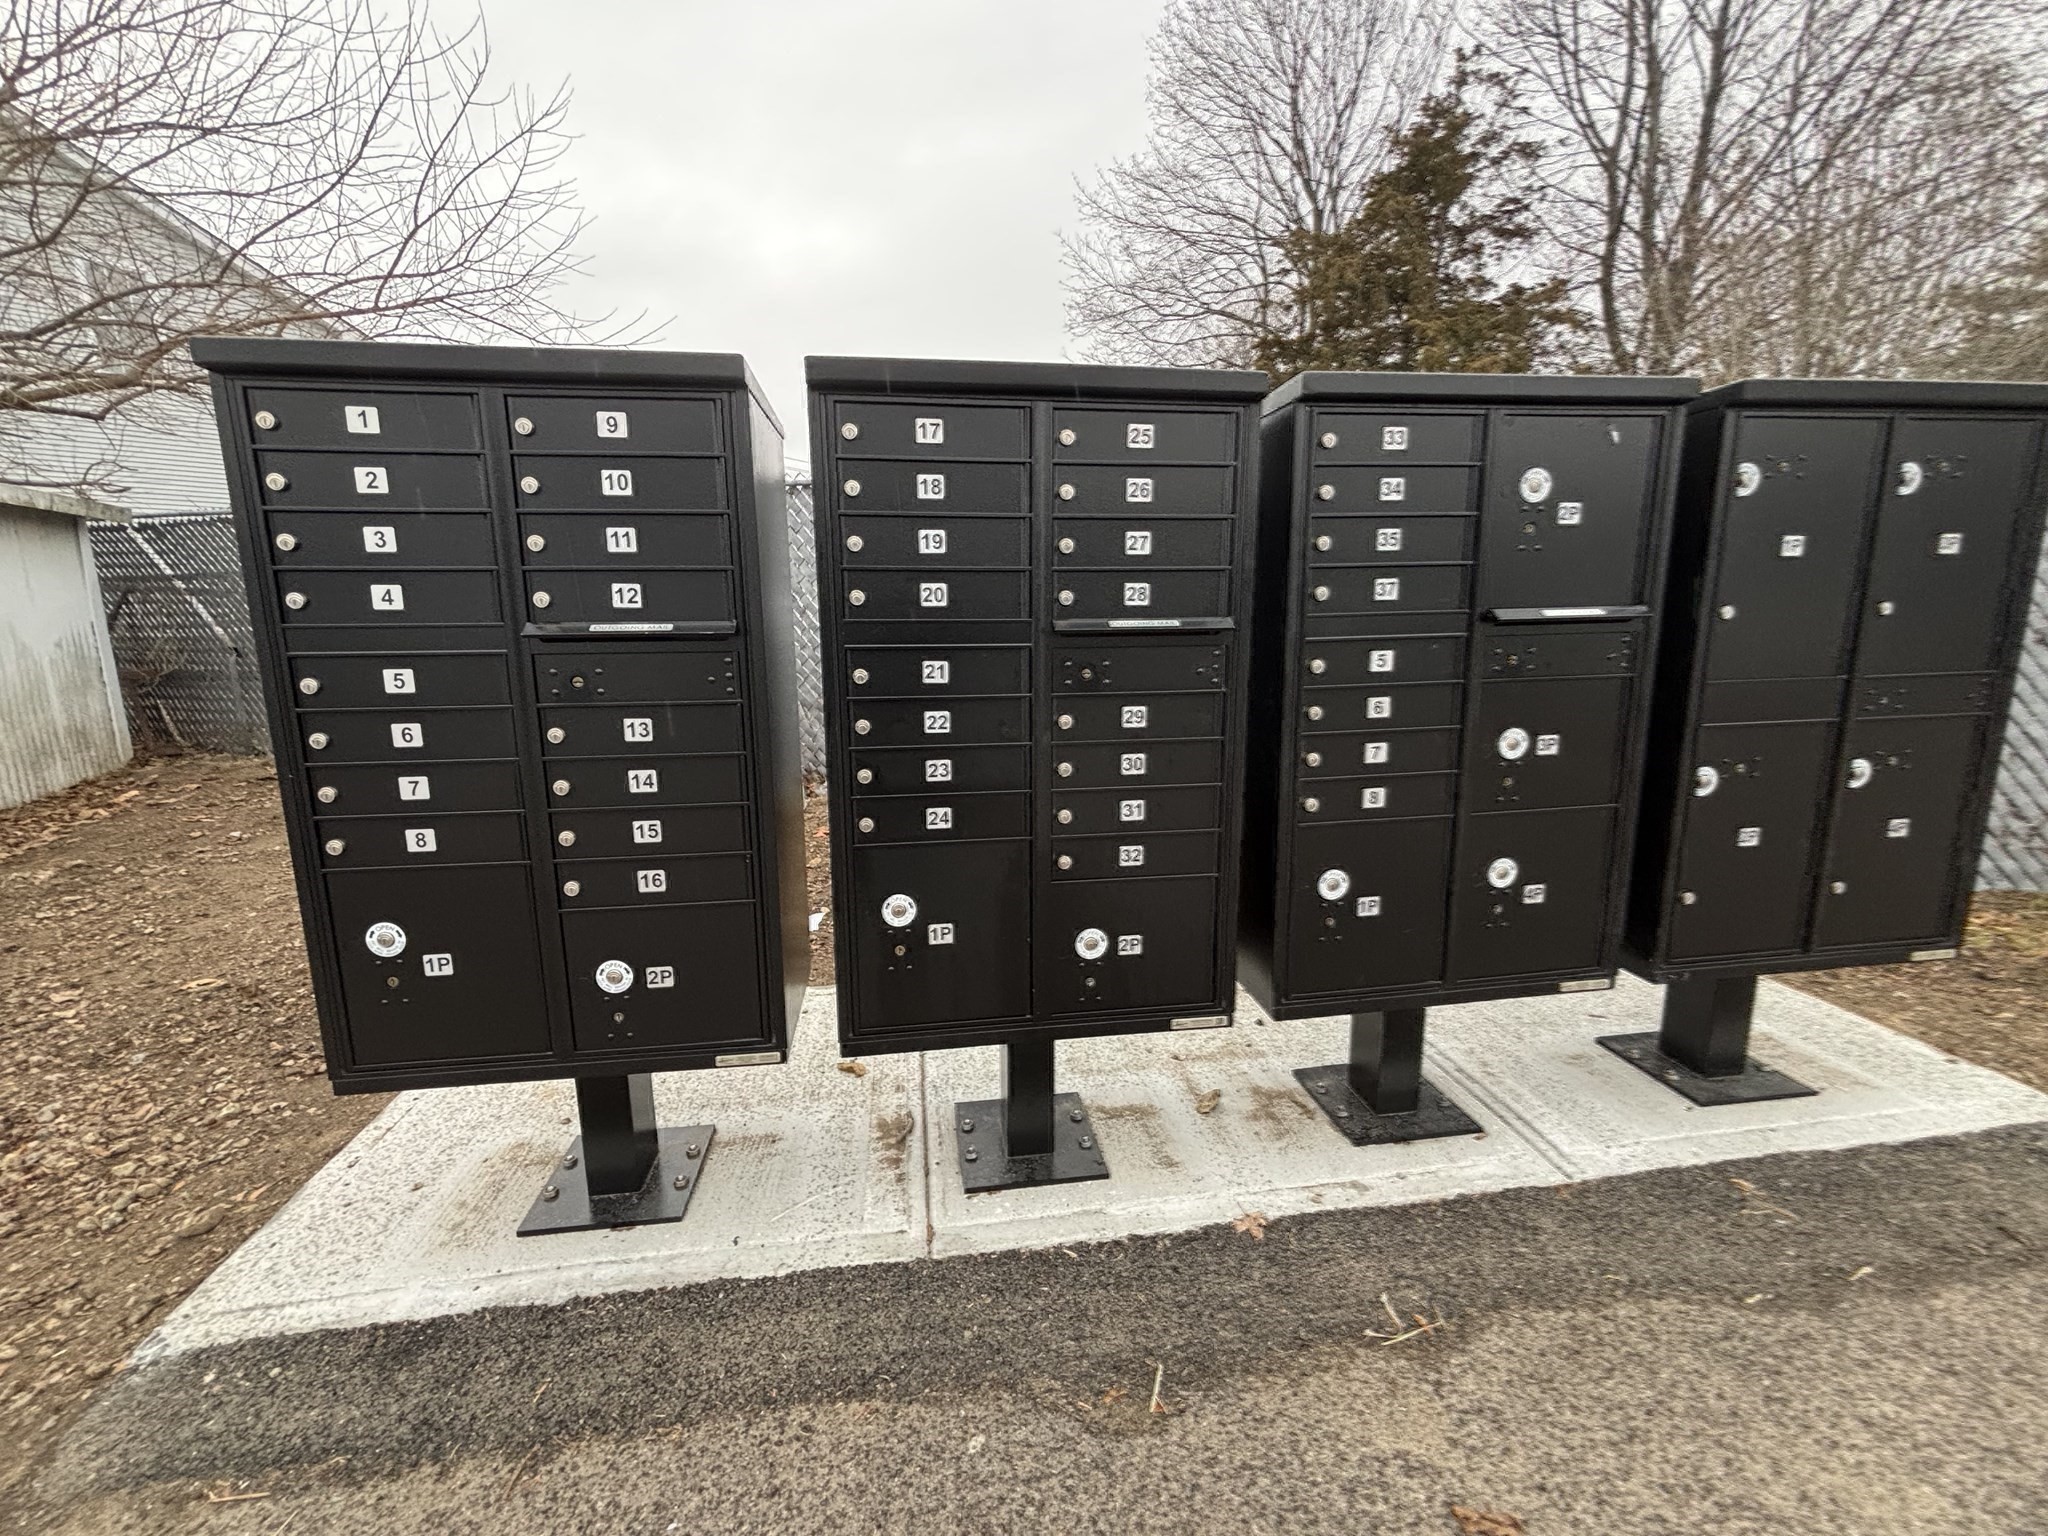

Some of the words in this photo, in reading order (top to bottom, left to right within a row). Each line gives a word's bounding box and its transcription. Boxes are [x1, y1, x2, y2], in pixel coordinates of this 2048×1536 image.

[358, 410, 368, 429] 1
[606, 416, 618, 434] 9
[918, 423, 941, 439] 17
[1129, 428, 1152, 444] 25
[1385, 431, 1405, 446] 33
[366, 472, 380, 490] 2
[604, 474, 629, 490] 10
[919, 479, 943, 495] 18
[1128, 482, 1150, 498] 26
[1381, 482, 1403, 497] 34
[1559, 505, 1580, 521] 2P
[374, 531, 387, 549] 3
[610, 531, 631, 547] 11
[921, 534, 944, 549] 19
[1127, 536, 1149, 550] 27
[1378, 532, 1399, 547] 35
[614, 588, 639, 603] 12
[922, 587, 945, 602] 20
[1126, 587, 1148, 601] 28
[1376, 582, 1397, 597] 37
[381, 589, 395, 606] 4
[1376, 654, 1387, 668] 5
[924, 664, 945, 679] 21
[394, 673, 406, 690] 5
[1373, 701, 1384, 715] 6
[926, 715, 948, 730] 22
[1124, 710, 1145, 724] 29
[402, 727, 414, 744] 6
[626, 722, 650, 737] 13
[1370, 745, 1382, 760] 7
[927, 763, 950, 777] 23
[1123, 757, 1144, 771] 30
[408, 781, 420, 797] 7
[631, 774, 655, 789] 14
[928, 811, 950, 825] 24
[1122, 804, 1142, 817] 31
[635, 824, 659, 838] 15
[416, 833, 427, 849] 8
[1121, 849, 1142, 862] 32
[640, 873, 663, 888] 16
[1357, 899, 1378, 913] 1P
[375, 924, 396, 932] OPEN
[929, 926, 952, 941] 1P
[1119, 937, 1141, 952] 2P
[426, 958, 451, 973] 1P
[604, 962, 623, 970] OPEN
[648, 970, 672, 984] 2P
